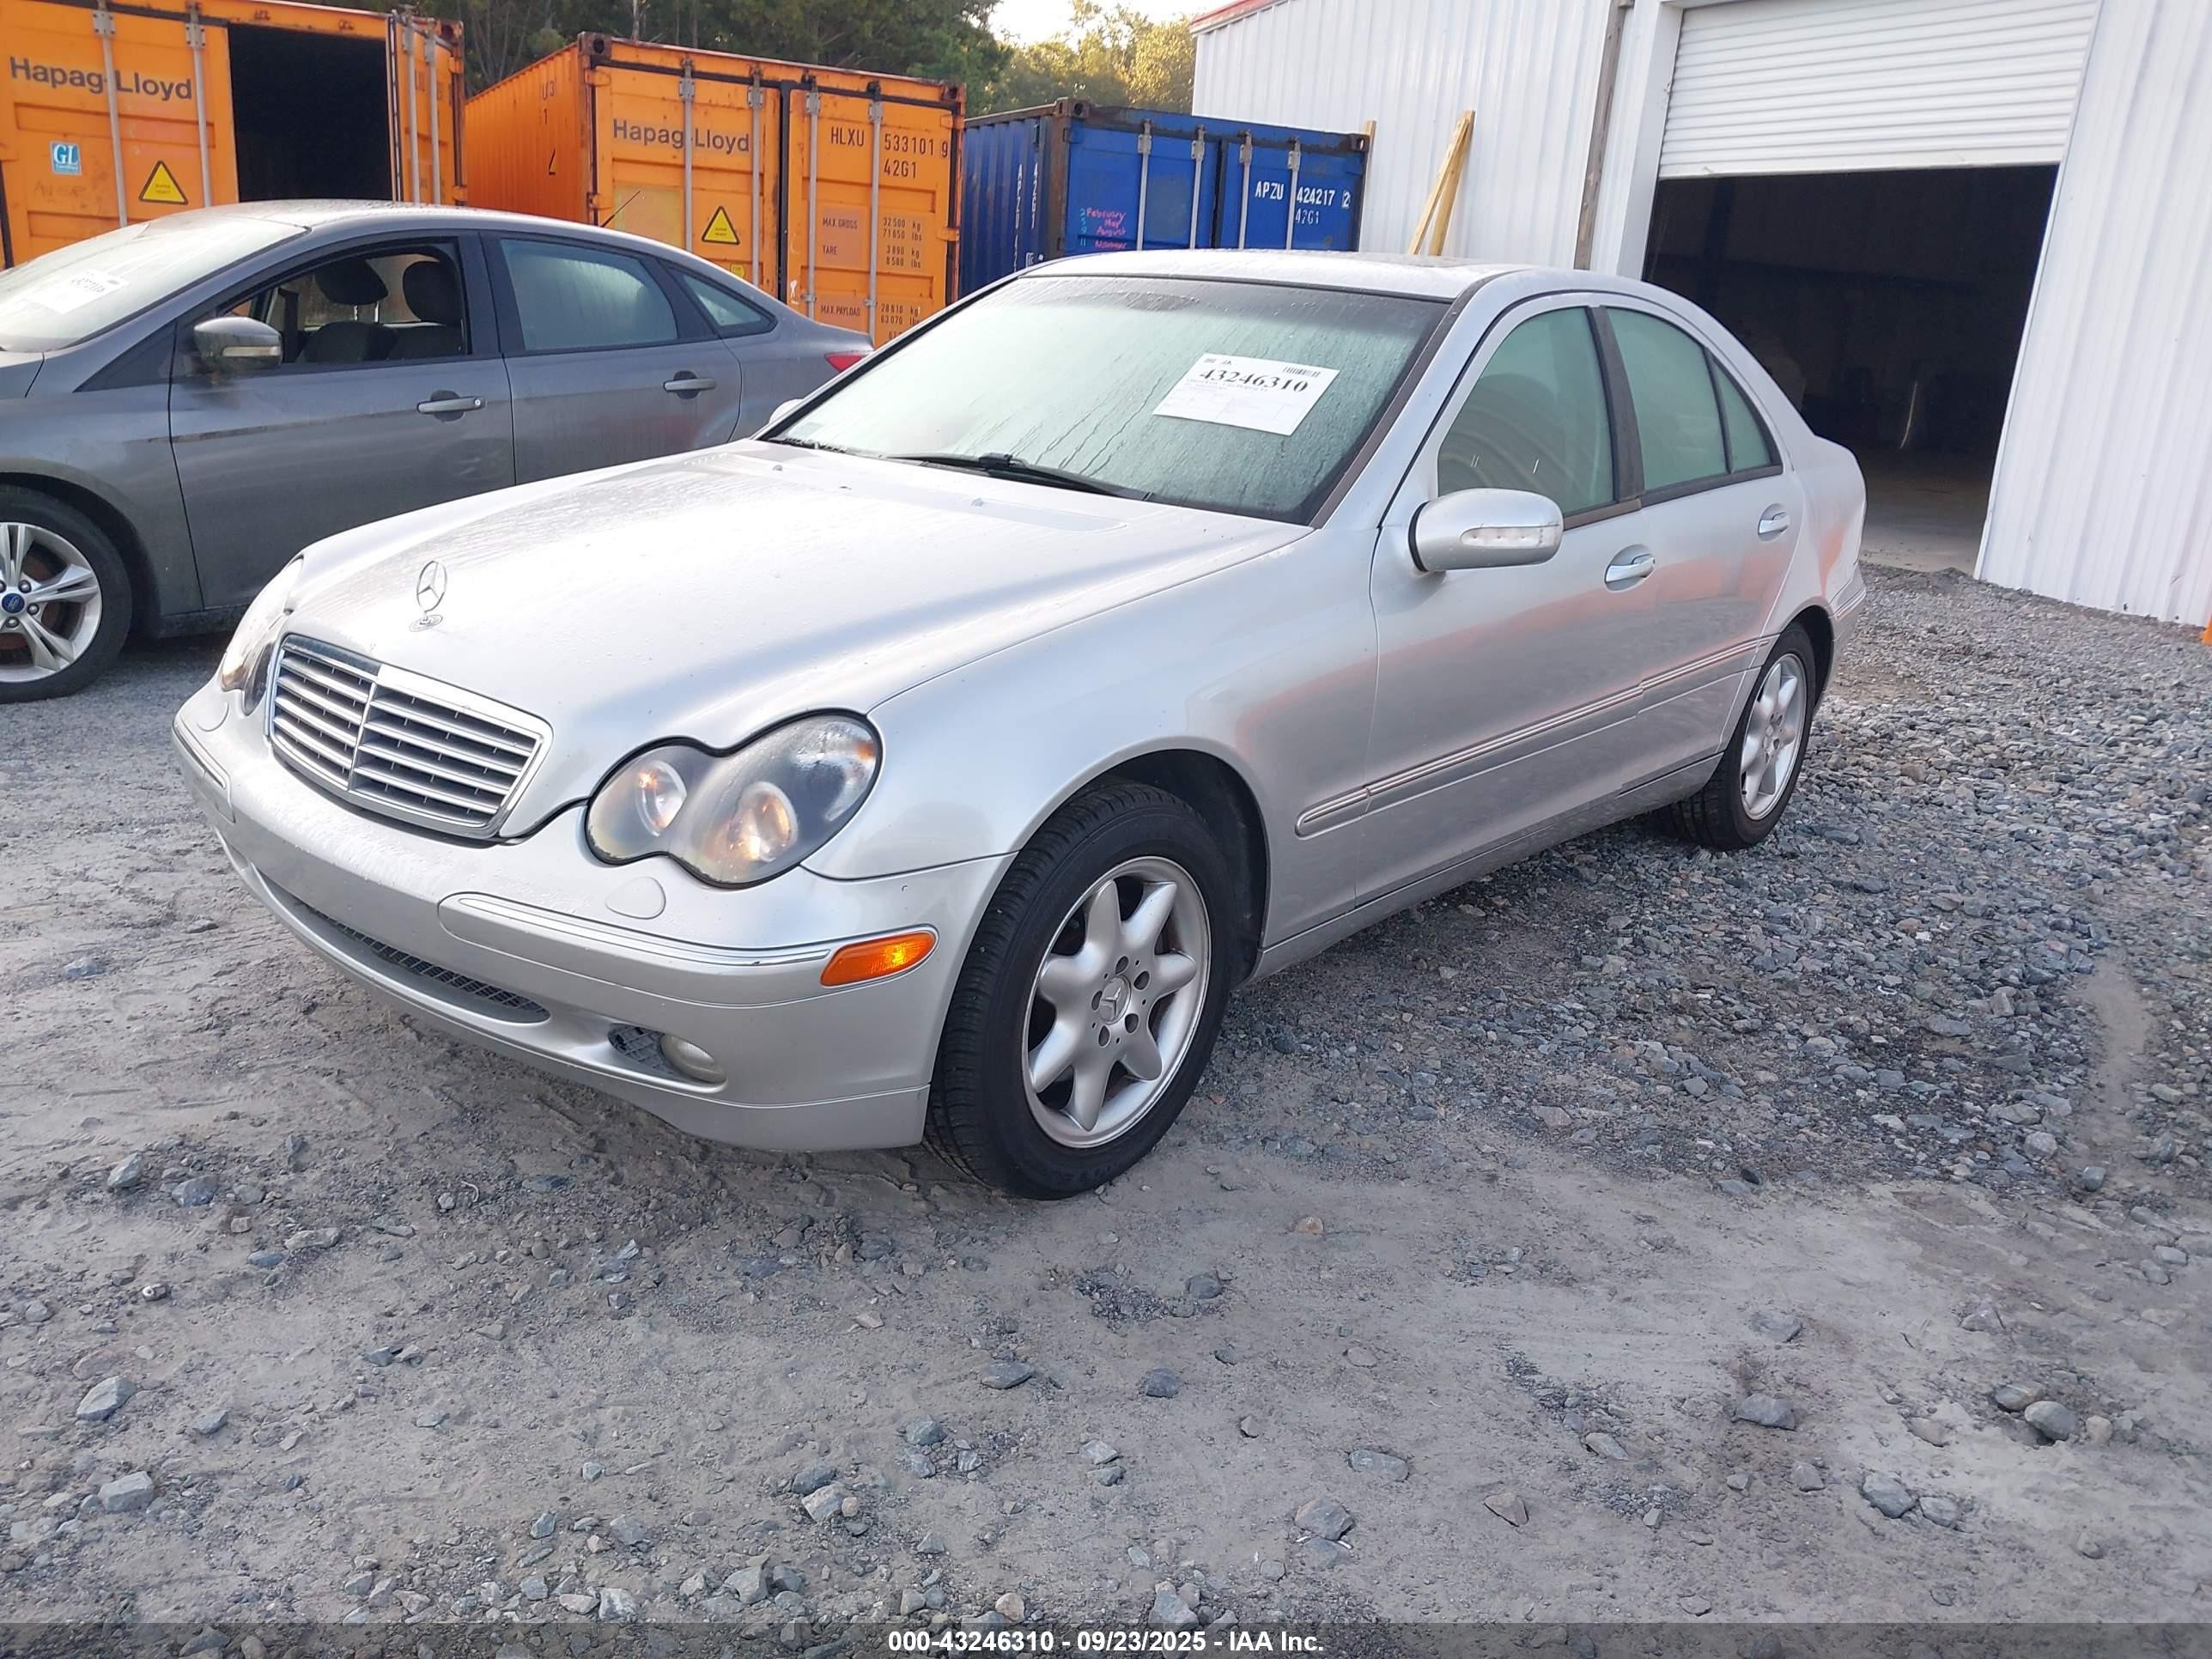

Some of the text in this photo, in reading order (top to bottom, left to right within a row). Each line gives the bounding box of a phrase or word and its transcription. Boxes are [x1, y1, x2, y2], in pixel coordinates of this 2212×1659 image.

[9, 56, 192, 100] HapagLloyd
[613, 118, 750, 155] HapagLloyd
[830, 126, 949, 158] HLXU 533101 9
[53, 143, 79, 166] GL
[884, 159, 917, 179] 42G1
[1255, 180, 1351, 207] APZU 424217 2
[823, 245, 838, 256] TARE
[1200, 368, 1309, 392] 43246310
